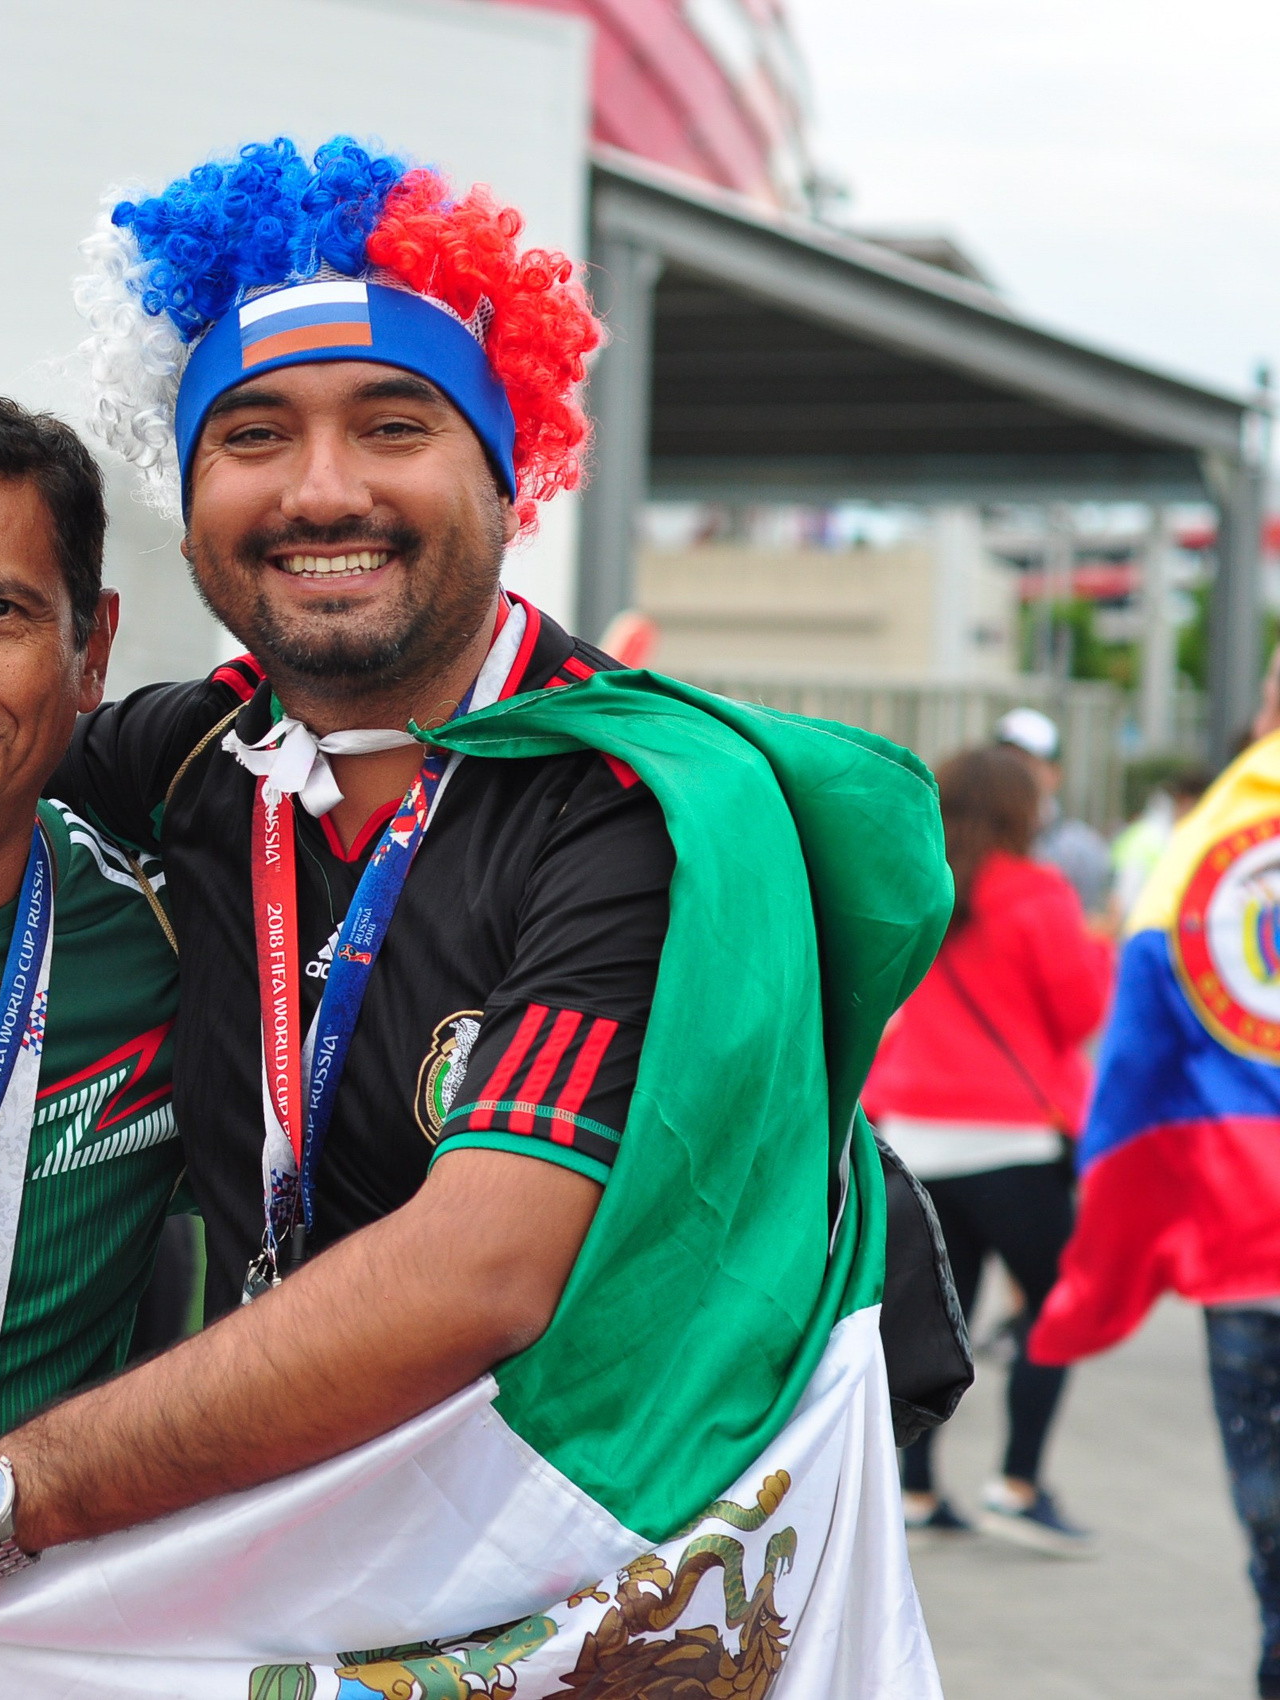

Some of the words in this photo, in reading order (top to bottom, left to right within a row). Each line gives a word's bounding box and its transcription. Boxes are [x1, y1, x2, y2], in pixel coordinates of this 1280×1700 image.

[18, 930, 36, 972] CUP
[27, 860, 43, 928] RUSSIA
[267, 902, 285, 948] 2018
[354, 908, 373, 945] RUSSIA
[363, 923, 377, 947] 2018
[270, 951, 287, 995] FIFA
[272, 996, 290, 1071] WORLD
[428, 1058, 444, 1088] MEXICANA
[274, 1075, 290, 1117] CUP
[306, 1114, 315, 1156] CUP
